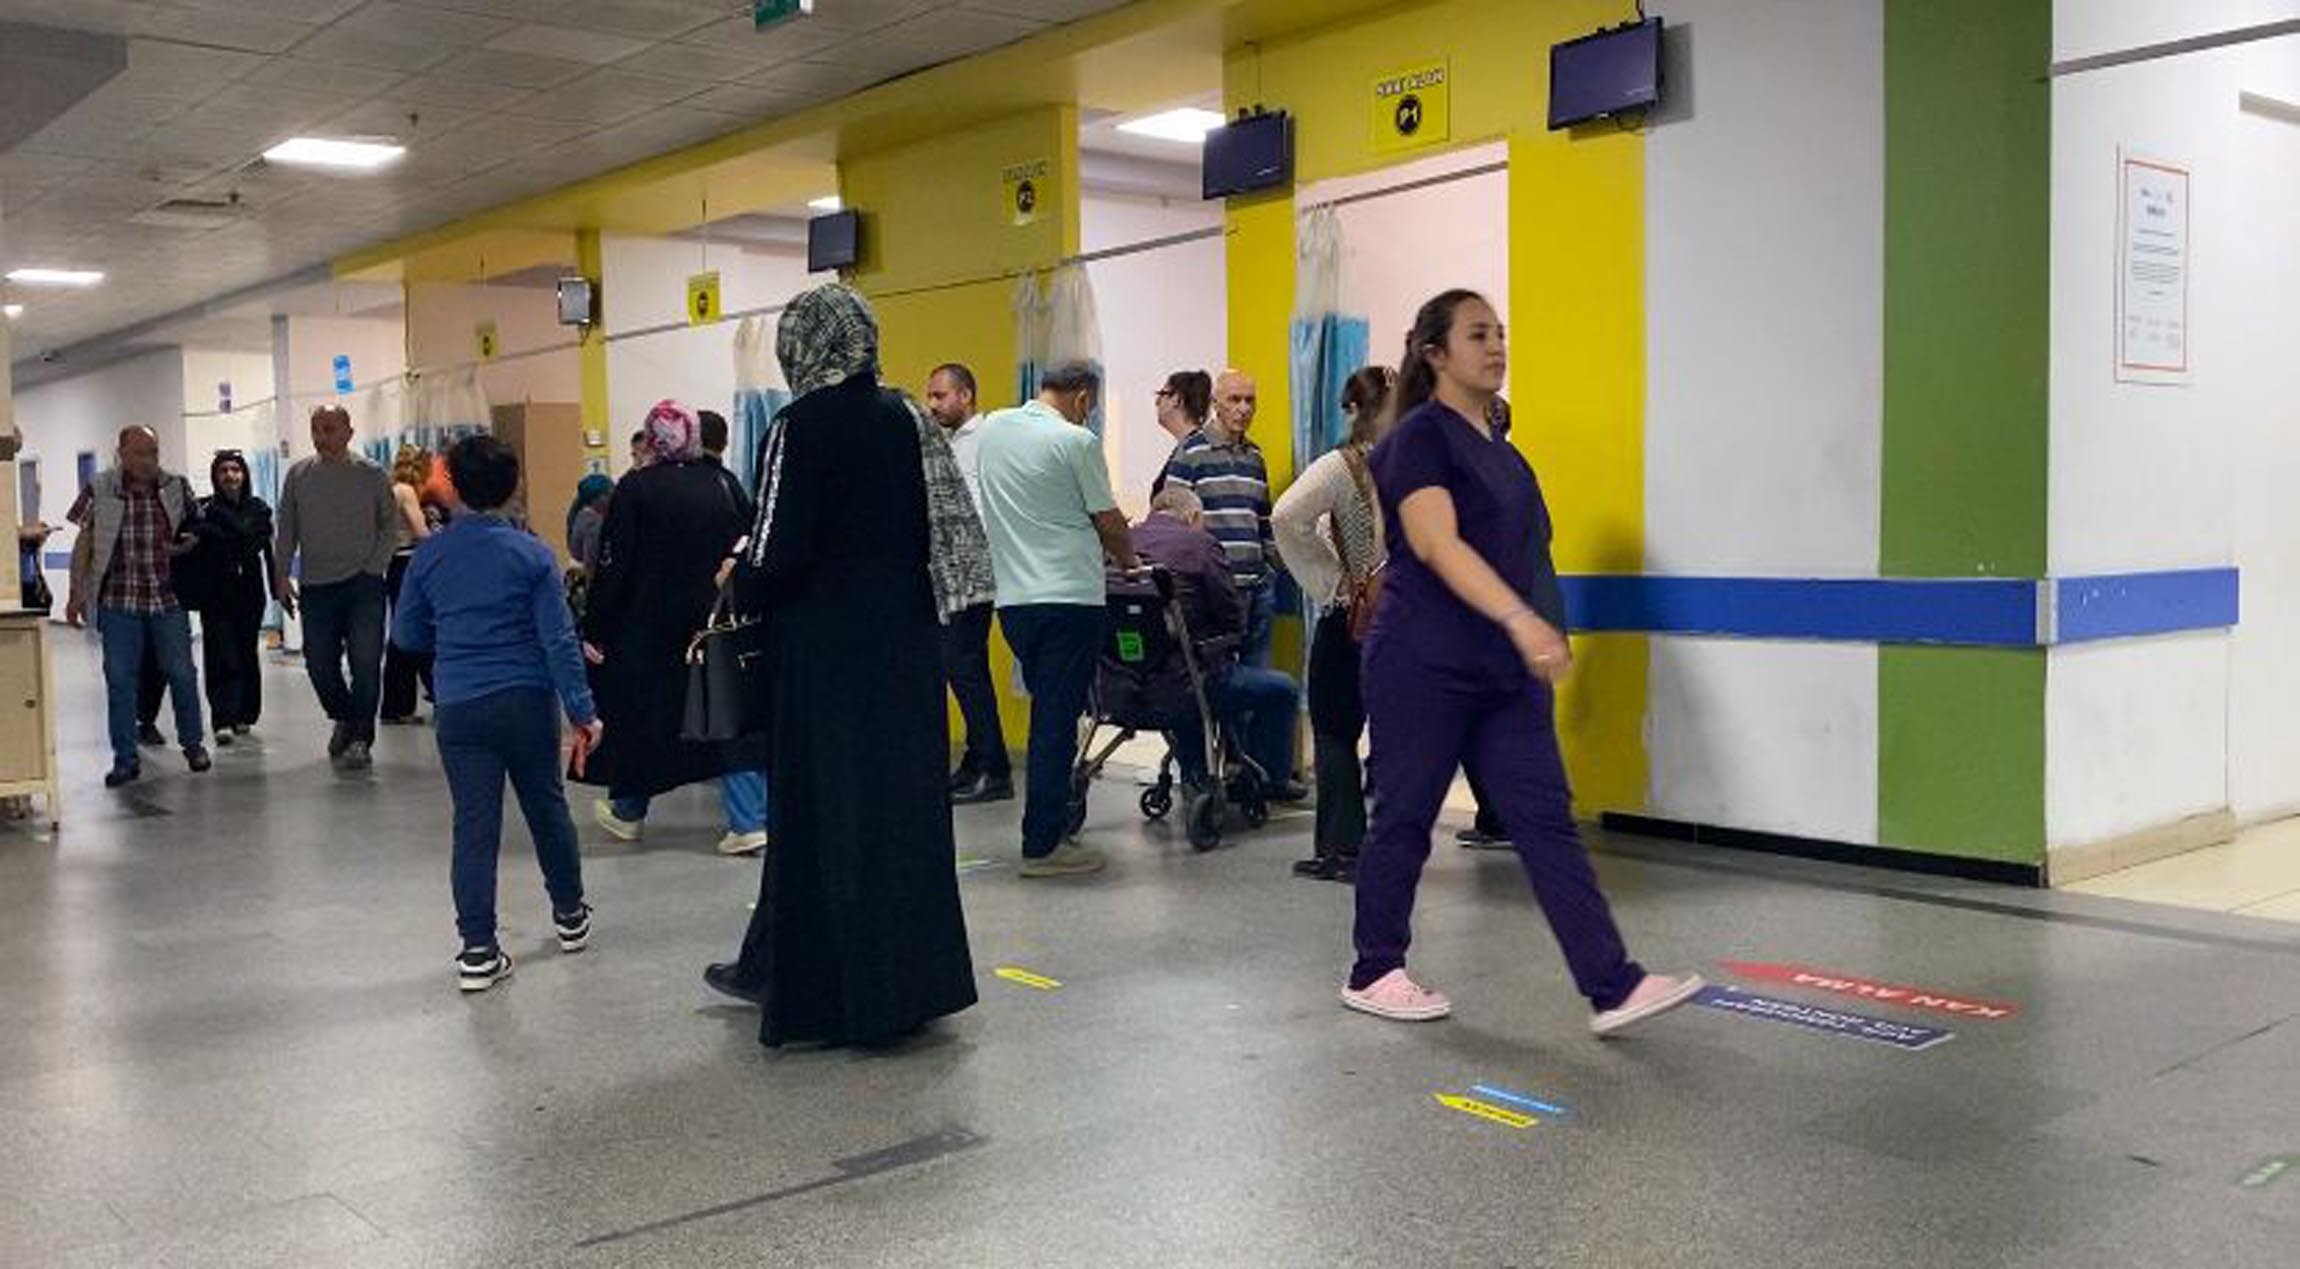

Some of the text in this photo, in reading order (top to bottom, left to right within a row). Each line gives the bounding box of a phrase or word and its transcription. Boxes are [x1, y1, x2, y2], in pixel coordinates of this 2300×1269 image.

[1400, 107, 1418, 125] P1
[1794, 973, 2007, 1017] KAN ALMA
